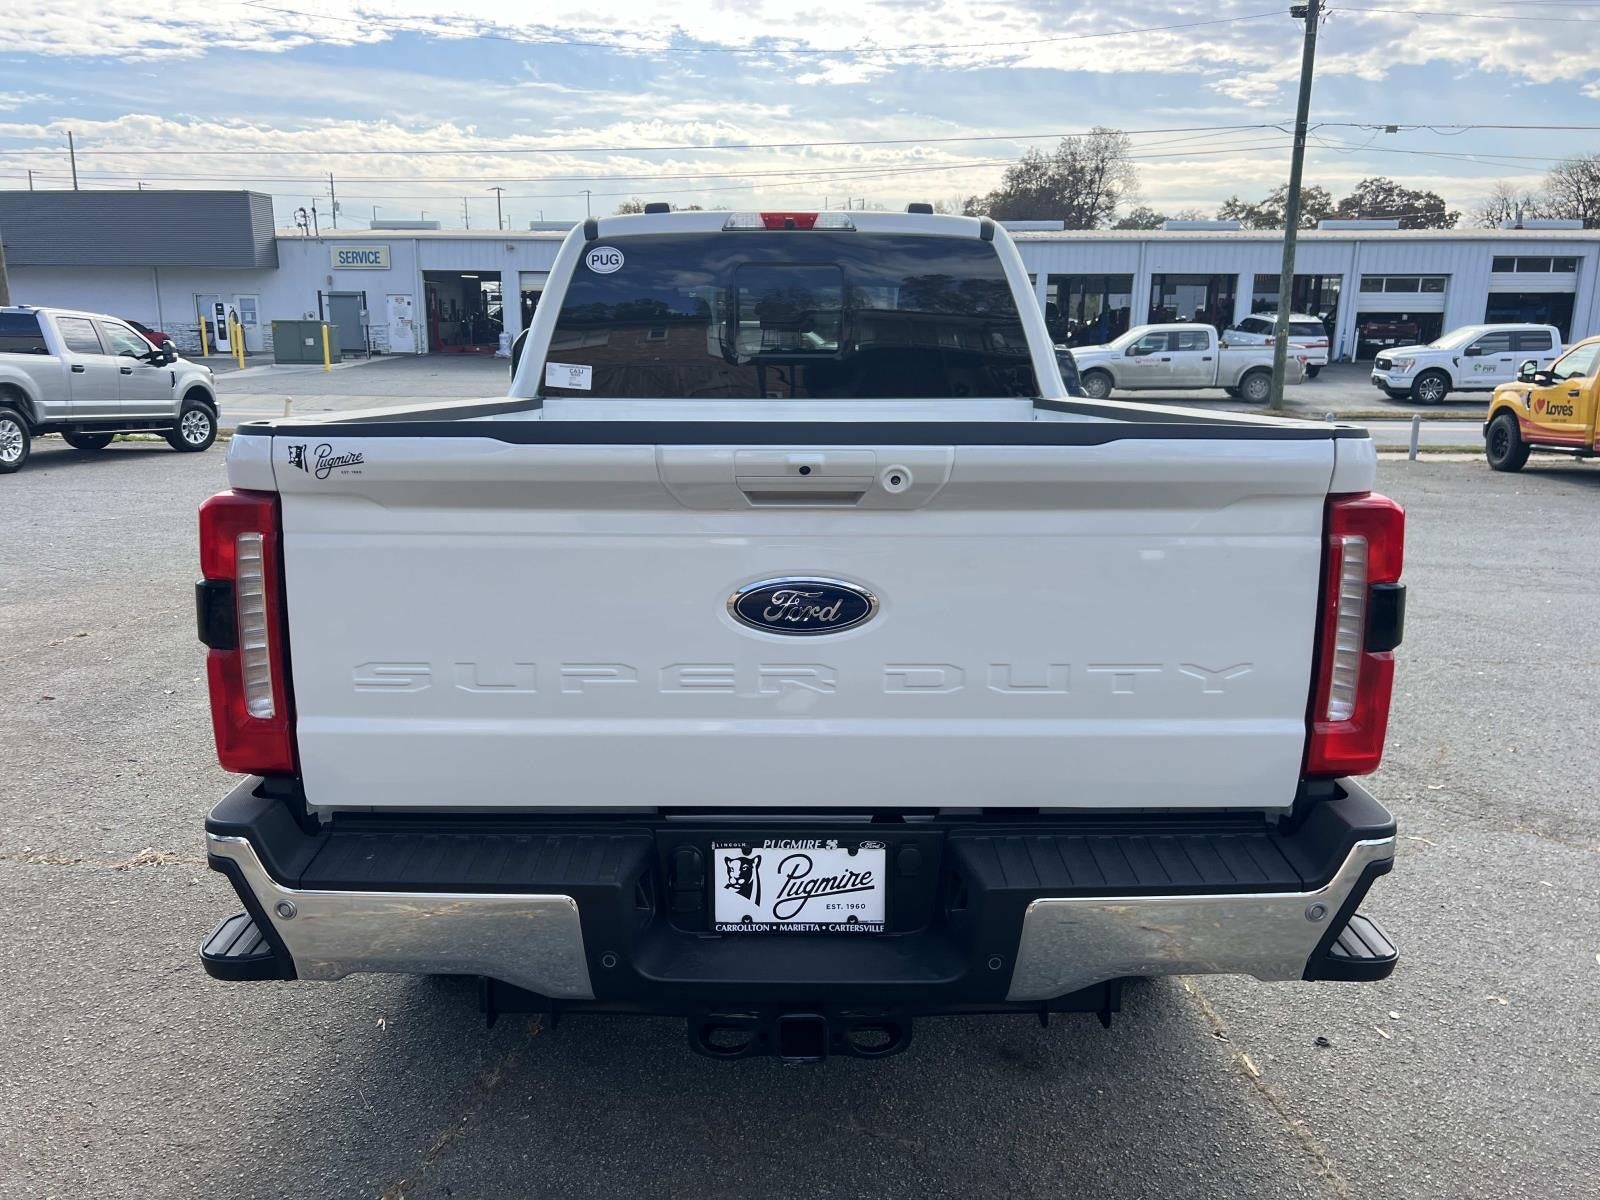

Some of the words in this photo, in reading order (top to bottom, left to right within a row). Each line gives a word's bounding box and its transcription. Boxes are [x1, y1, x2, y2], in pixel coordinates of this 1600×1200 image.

[338, 250, 381, 264] SERVICE
[591, 253, 619, 266] PUG
[1545, 399, 1573, 416] Love's
[313, 443, 364, 480] Pugmire
[763, 589, 844, 622] Ford
[352, 661, 838, 694] SUPER
[883, 662, 1254, 694] DUTY
[763, 839, 822, 849] PUGMIRE
[772, 853, 875, 920] Pugmire
[715, 924, 770, 932] CARROLLTON
[828, 924, 885, 932] CARTERSVILLE
